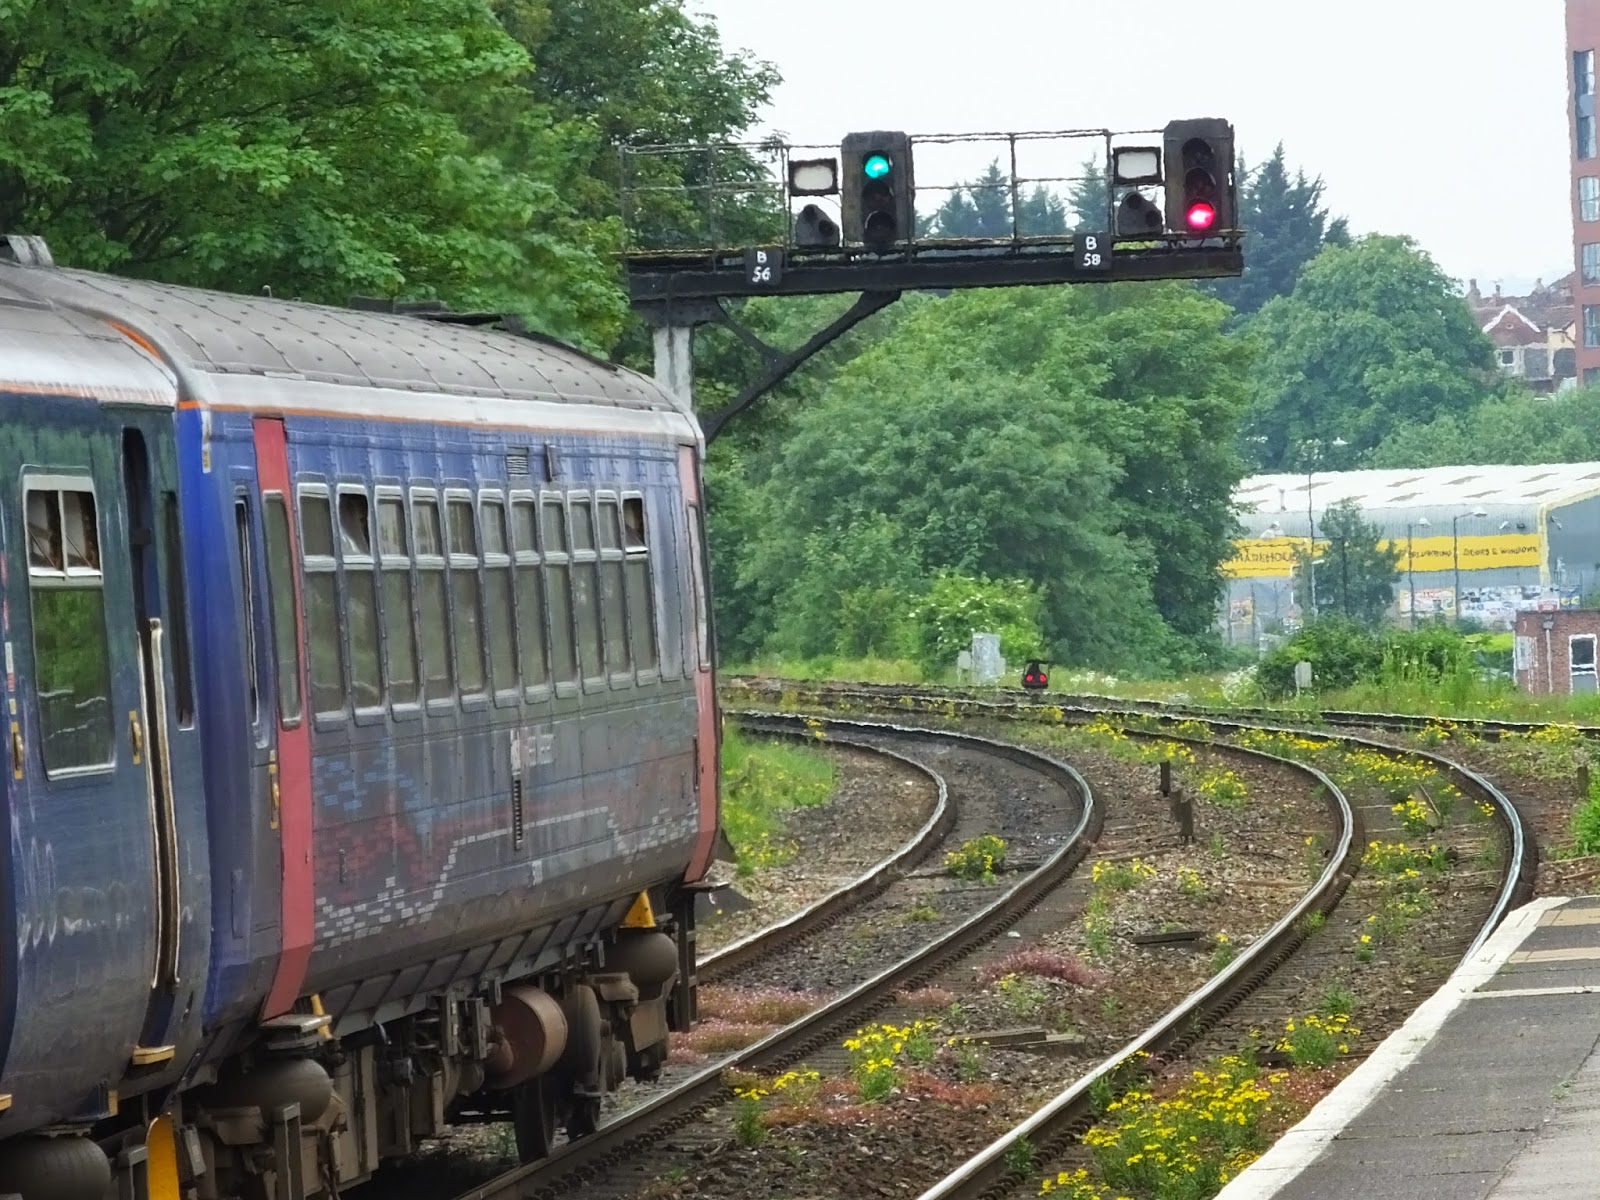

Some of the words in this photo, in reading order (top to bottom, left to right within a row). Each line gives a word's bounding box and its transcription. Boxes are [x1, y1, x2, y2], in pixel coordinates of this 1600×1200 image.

[1085, 235, 1098, 250] B
[756, 250, 767, 263] B
[1082, 252, 1101, 267] 58
[751, 265, 771, 282] 56
